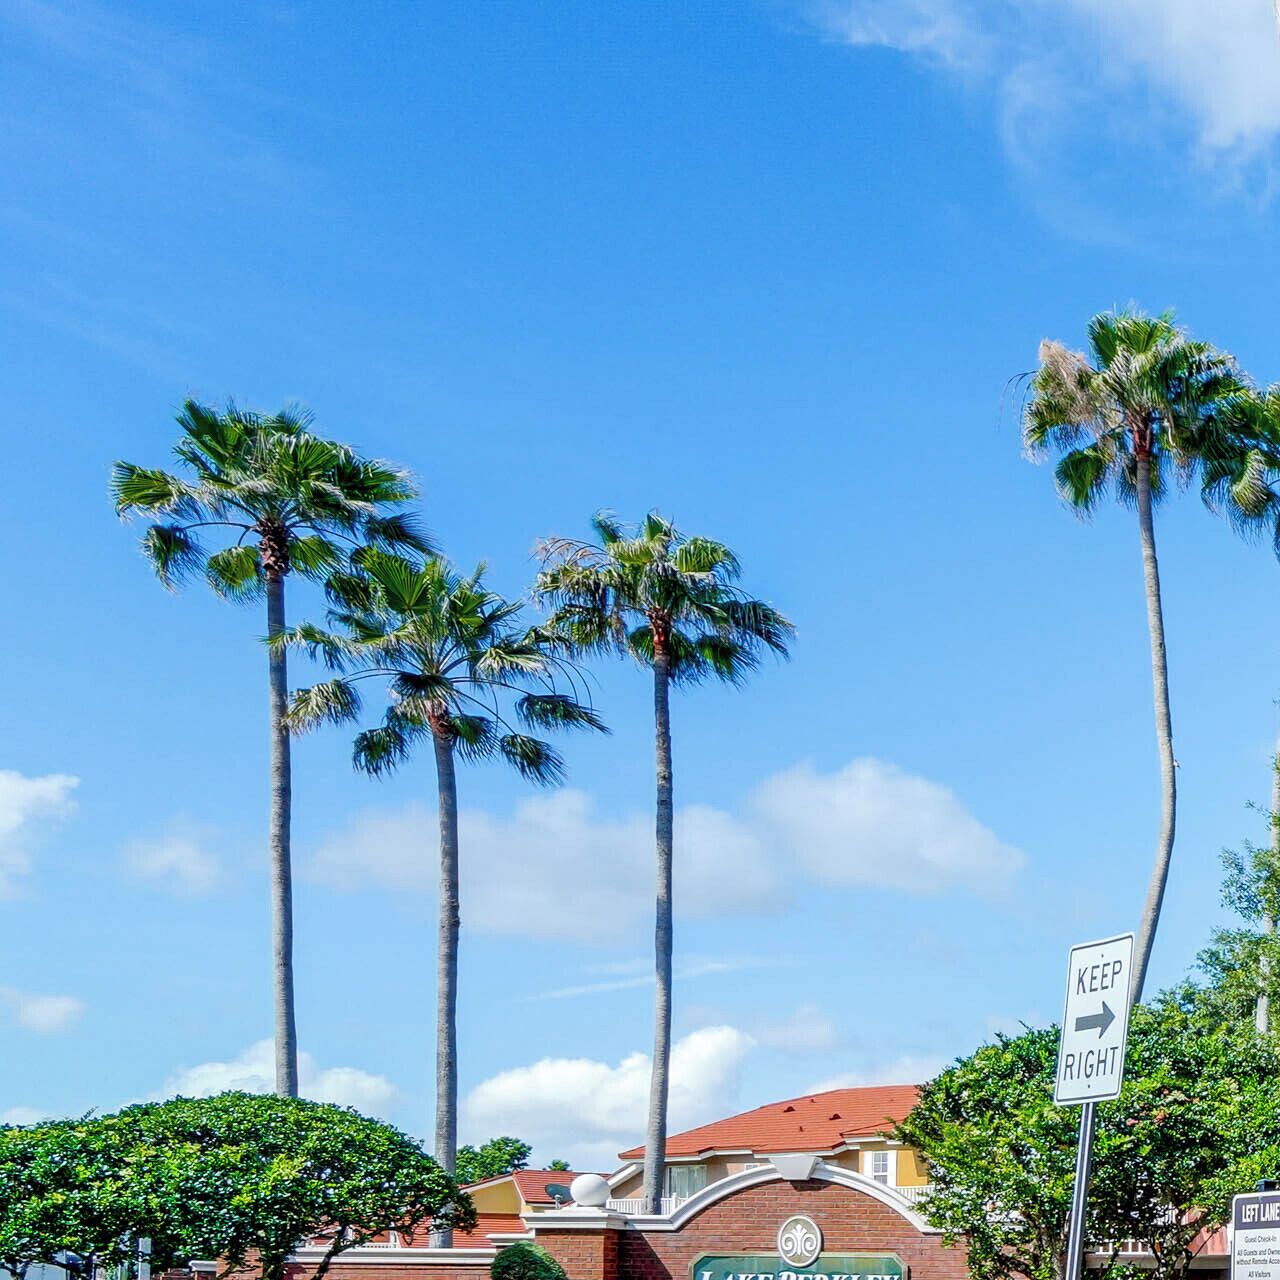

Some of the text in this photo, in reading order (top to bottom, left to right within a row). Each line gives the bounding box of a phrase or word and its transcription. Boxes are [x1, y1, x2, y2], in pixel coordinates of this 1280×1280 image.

[1076, 960, 1123, 995] KEEP
[1063, 1046, 1119, 1081] RIGHT
[1242, 1202, 1280, 1223] LEFT LANE
[1252, 1257, 1268, 1265] Remote
